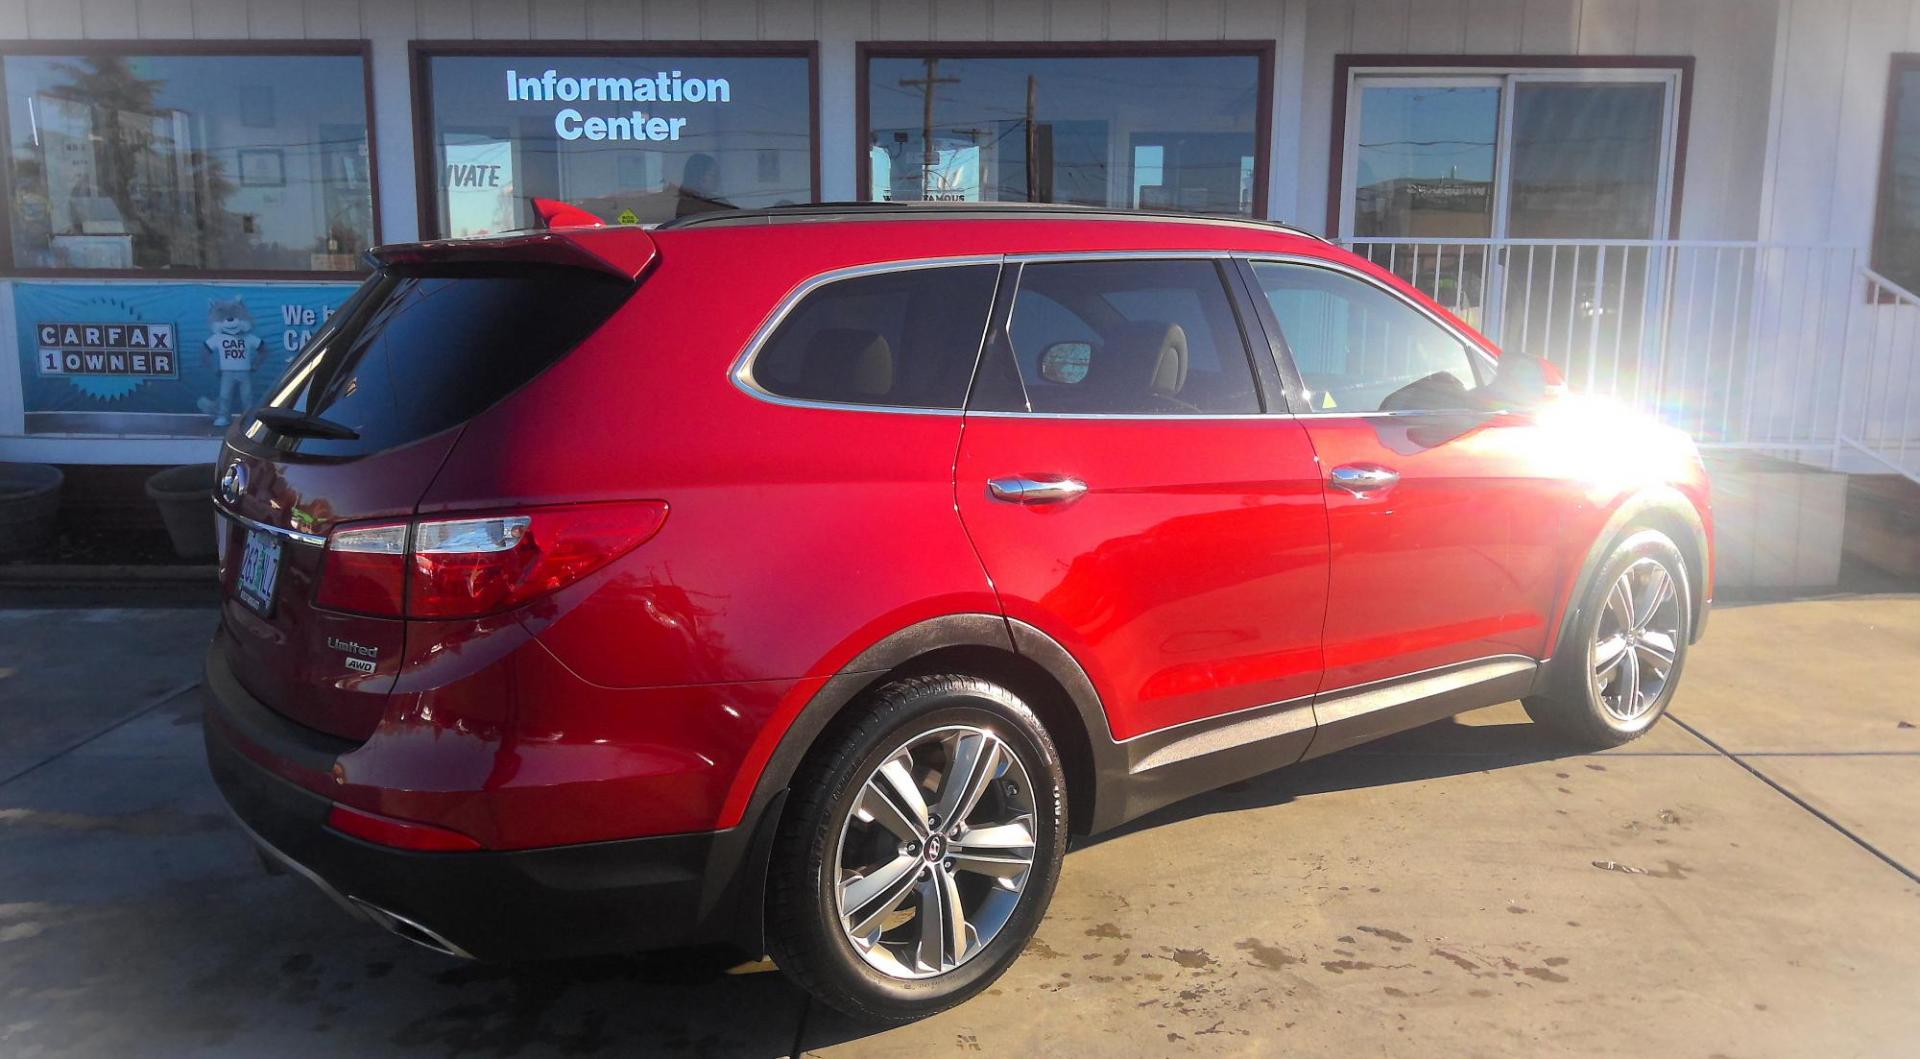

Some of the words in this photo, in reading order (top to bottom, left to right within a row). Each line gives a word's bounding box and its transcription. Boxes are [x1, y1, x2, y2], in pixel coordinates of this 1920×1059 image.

[506, 70, 730, 102] Information
[555, 109, 687, 141] Center
[281, 304, 316, 326] We
[41, 326, 168, 348] CARFAX
[222, 339, 246, 349] CAR
[45, 353, 58, 370] 1
[65, 354, 169, 371] OWNER
[224, 350, 246, 359] FOX
[327, 636, 378, 658] Limited
[348, 659, 373, 672] AWD
